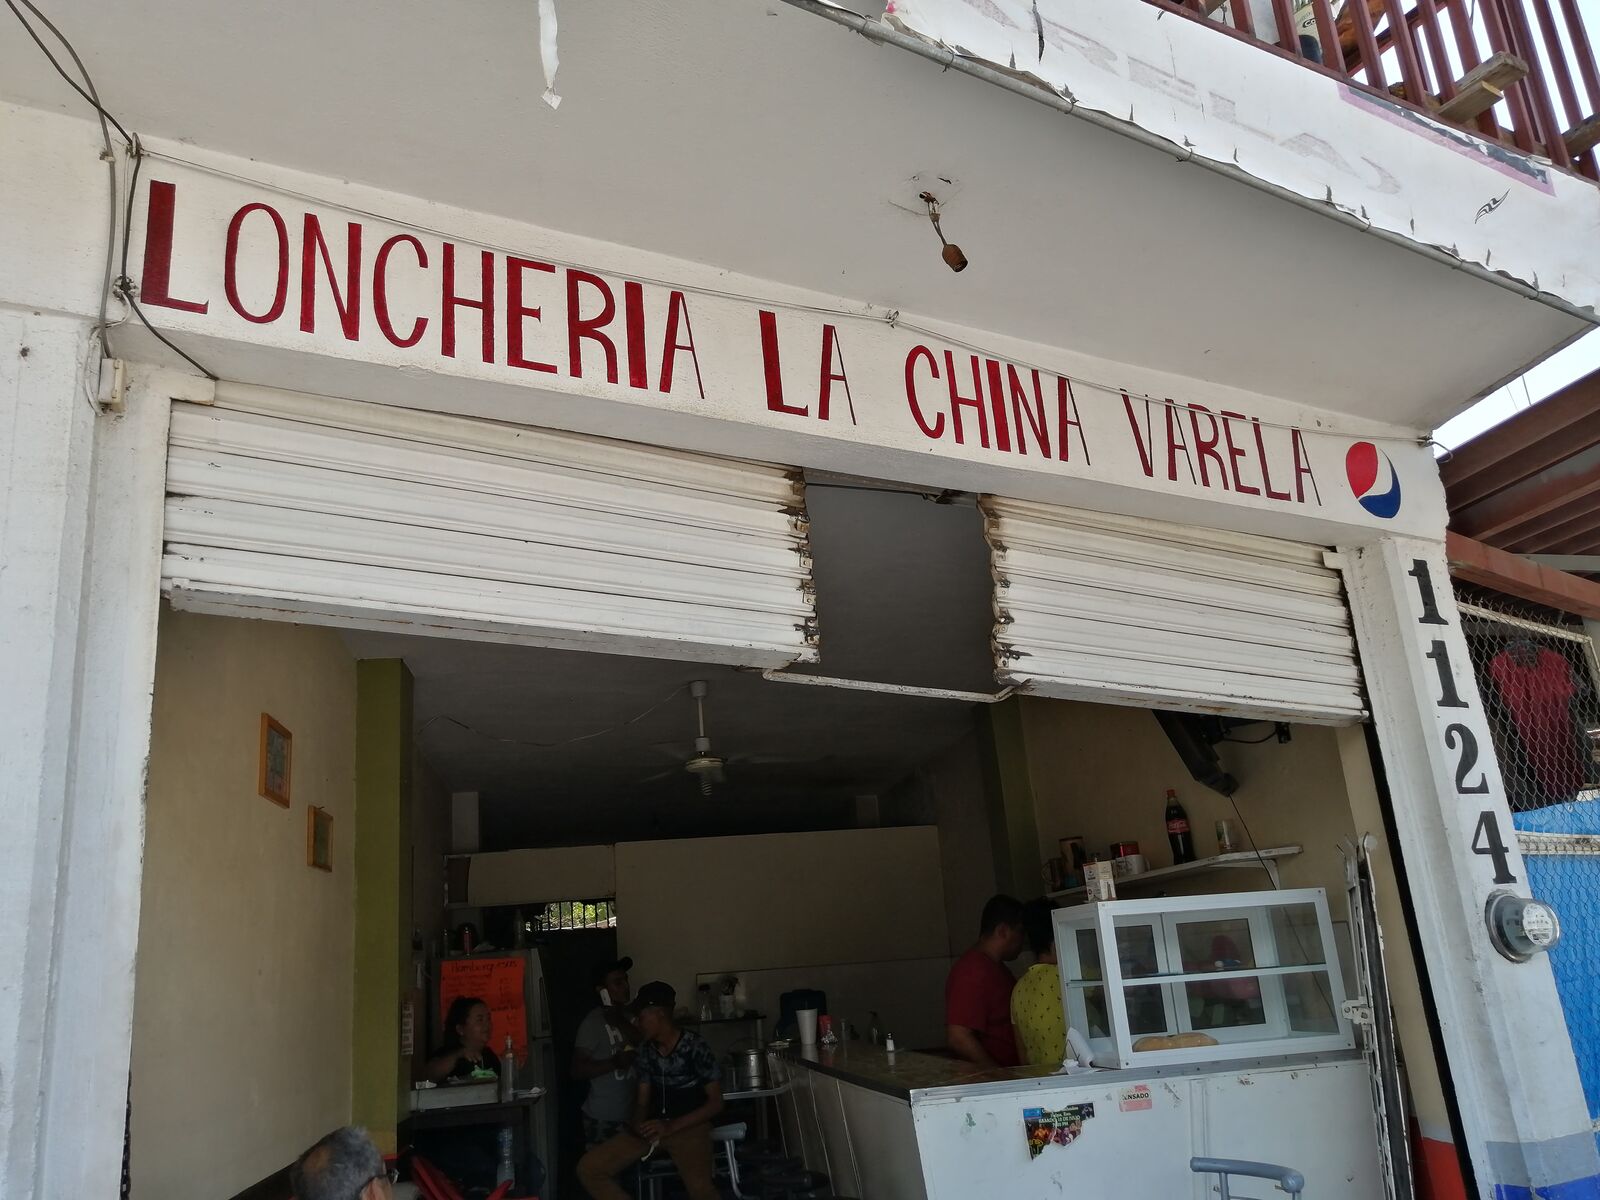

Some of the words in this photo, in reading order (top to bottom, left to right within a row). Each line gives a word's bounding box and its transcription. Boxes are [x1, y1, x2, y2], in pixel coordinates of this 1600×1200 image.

[140, 180, 705, 400] LONCHERIA
[758, 310, 857, 425] LA
[905, 344, 1091, 466] CHINA
[1119, 387, 1322, 506] VARELA
[1408, 559, 1517, 884] 1124
